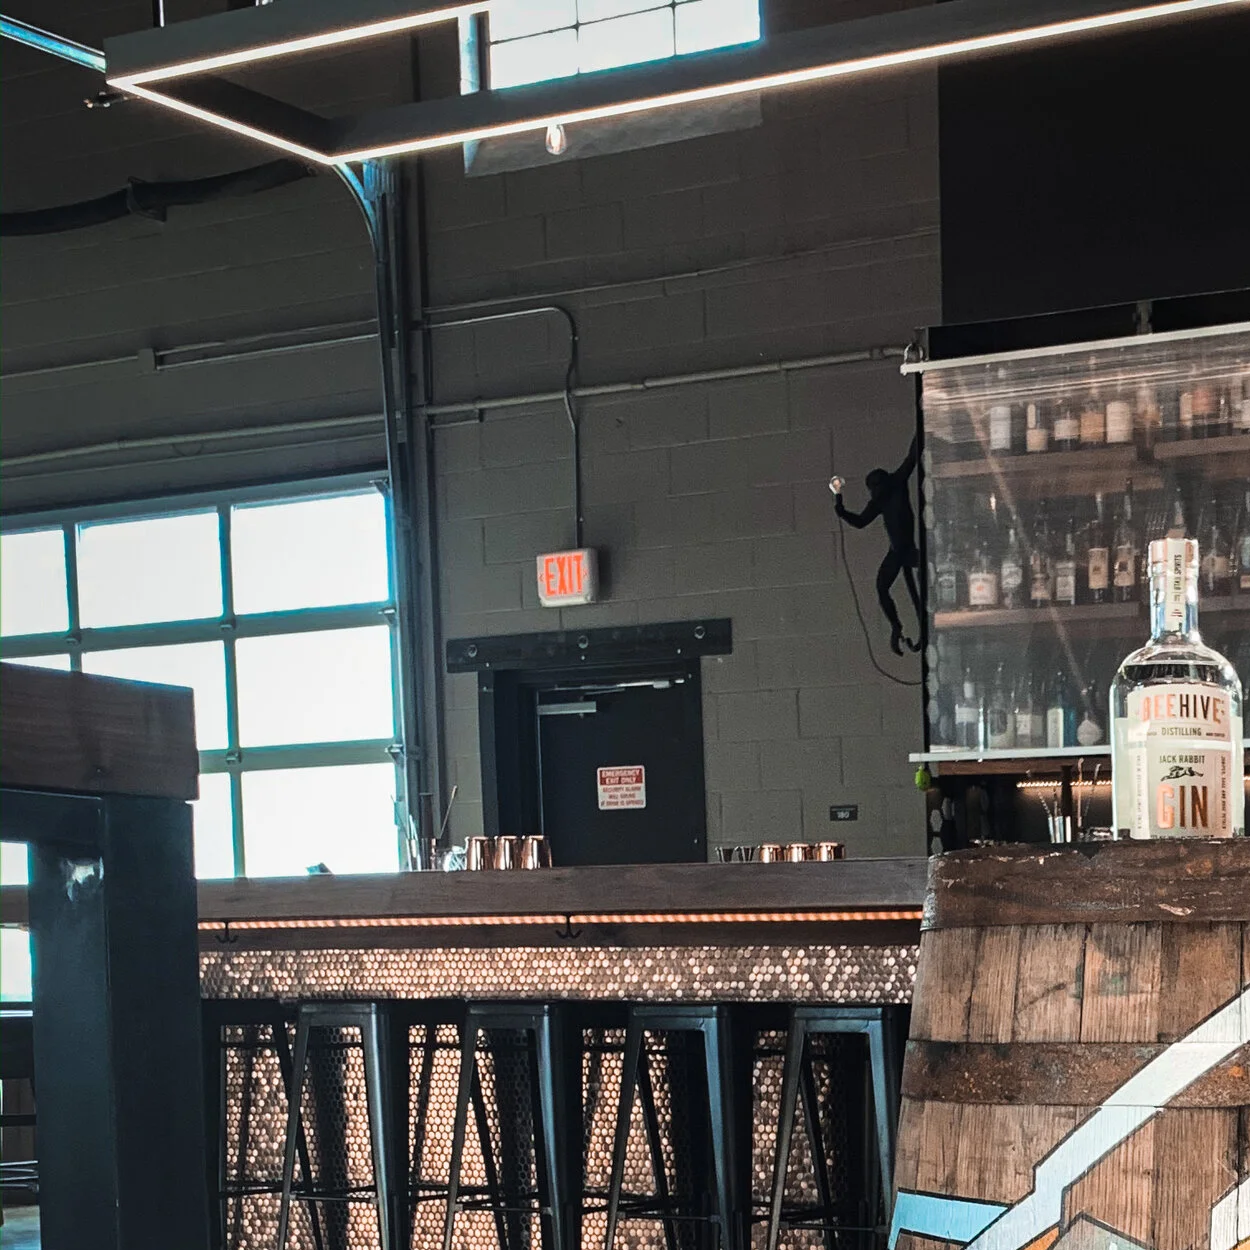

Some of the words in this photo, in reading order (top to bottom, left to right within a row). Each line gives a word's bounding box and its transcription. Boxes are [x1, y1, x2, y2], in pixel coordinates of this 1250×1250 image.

[544, 555, 583, 596] EXIT
[1142, 693, 1221, 724] BEEHIVE
[1161, 727, 1202, 737] DISTILLING
[1159, 755, 1177, 764] JACK
[1179, 755, 1205, 764] RABBIT
[602, 769, 641, 778] EMERGENCY
[606, 777, 619, 785] EXIT
[620, 776, 636, 784] ONLY
[1157, 784, 1208, 829] GIN
